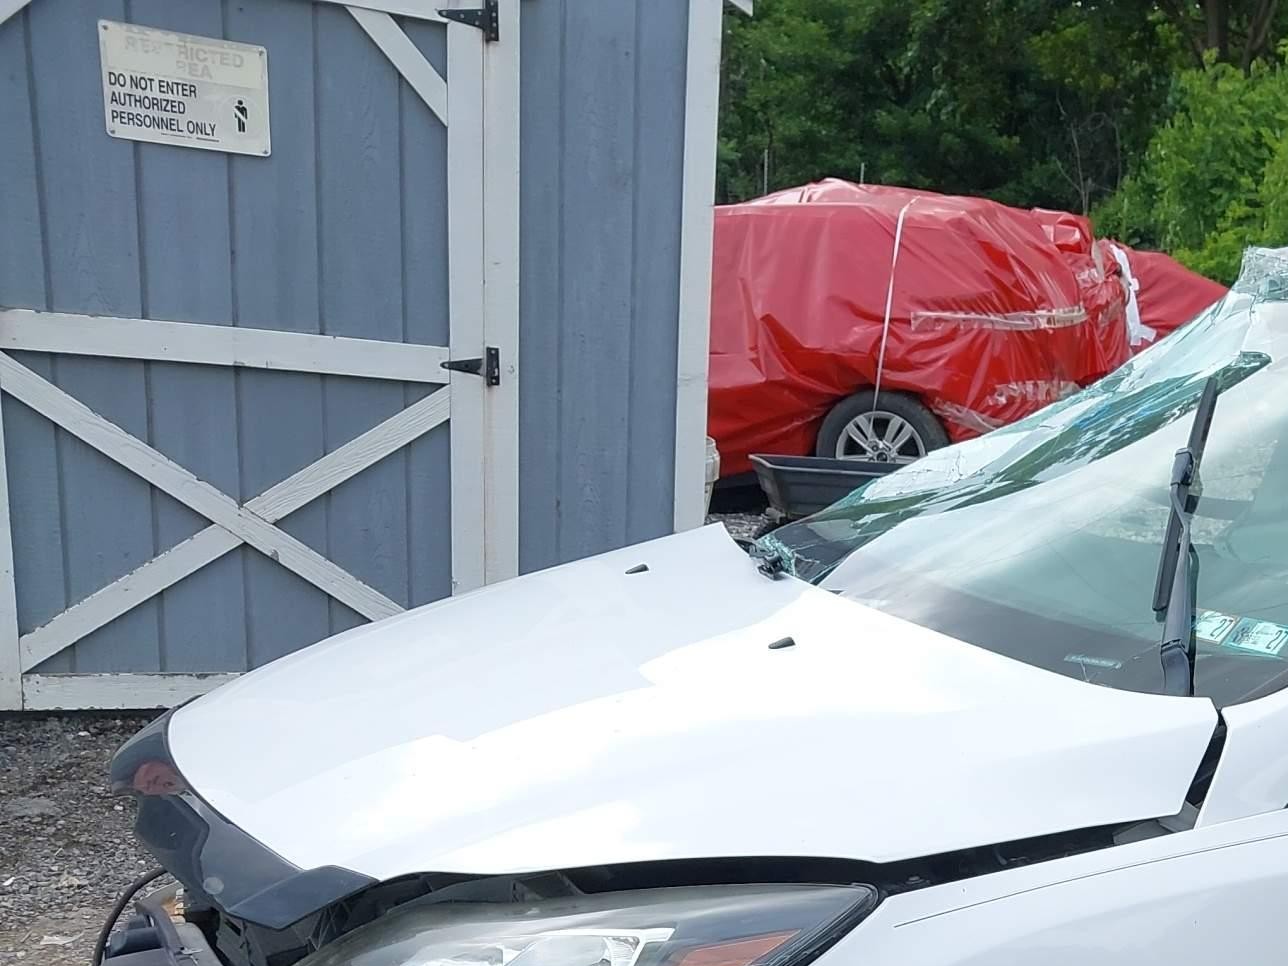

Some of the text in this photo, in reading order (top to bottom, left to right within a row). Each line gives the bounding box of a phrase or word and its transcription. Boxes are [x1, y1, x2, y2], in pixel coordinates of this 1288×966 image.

[108, 72, 198, 98] DO NOT ENTER
[110, 91, 186, 115] AUTHORIZED
[111, 110, 184, 133] PERSONNEL
[187, 120, 217, 137] ONLY
